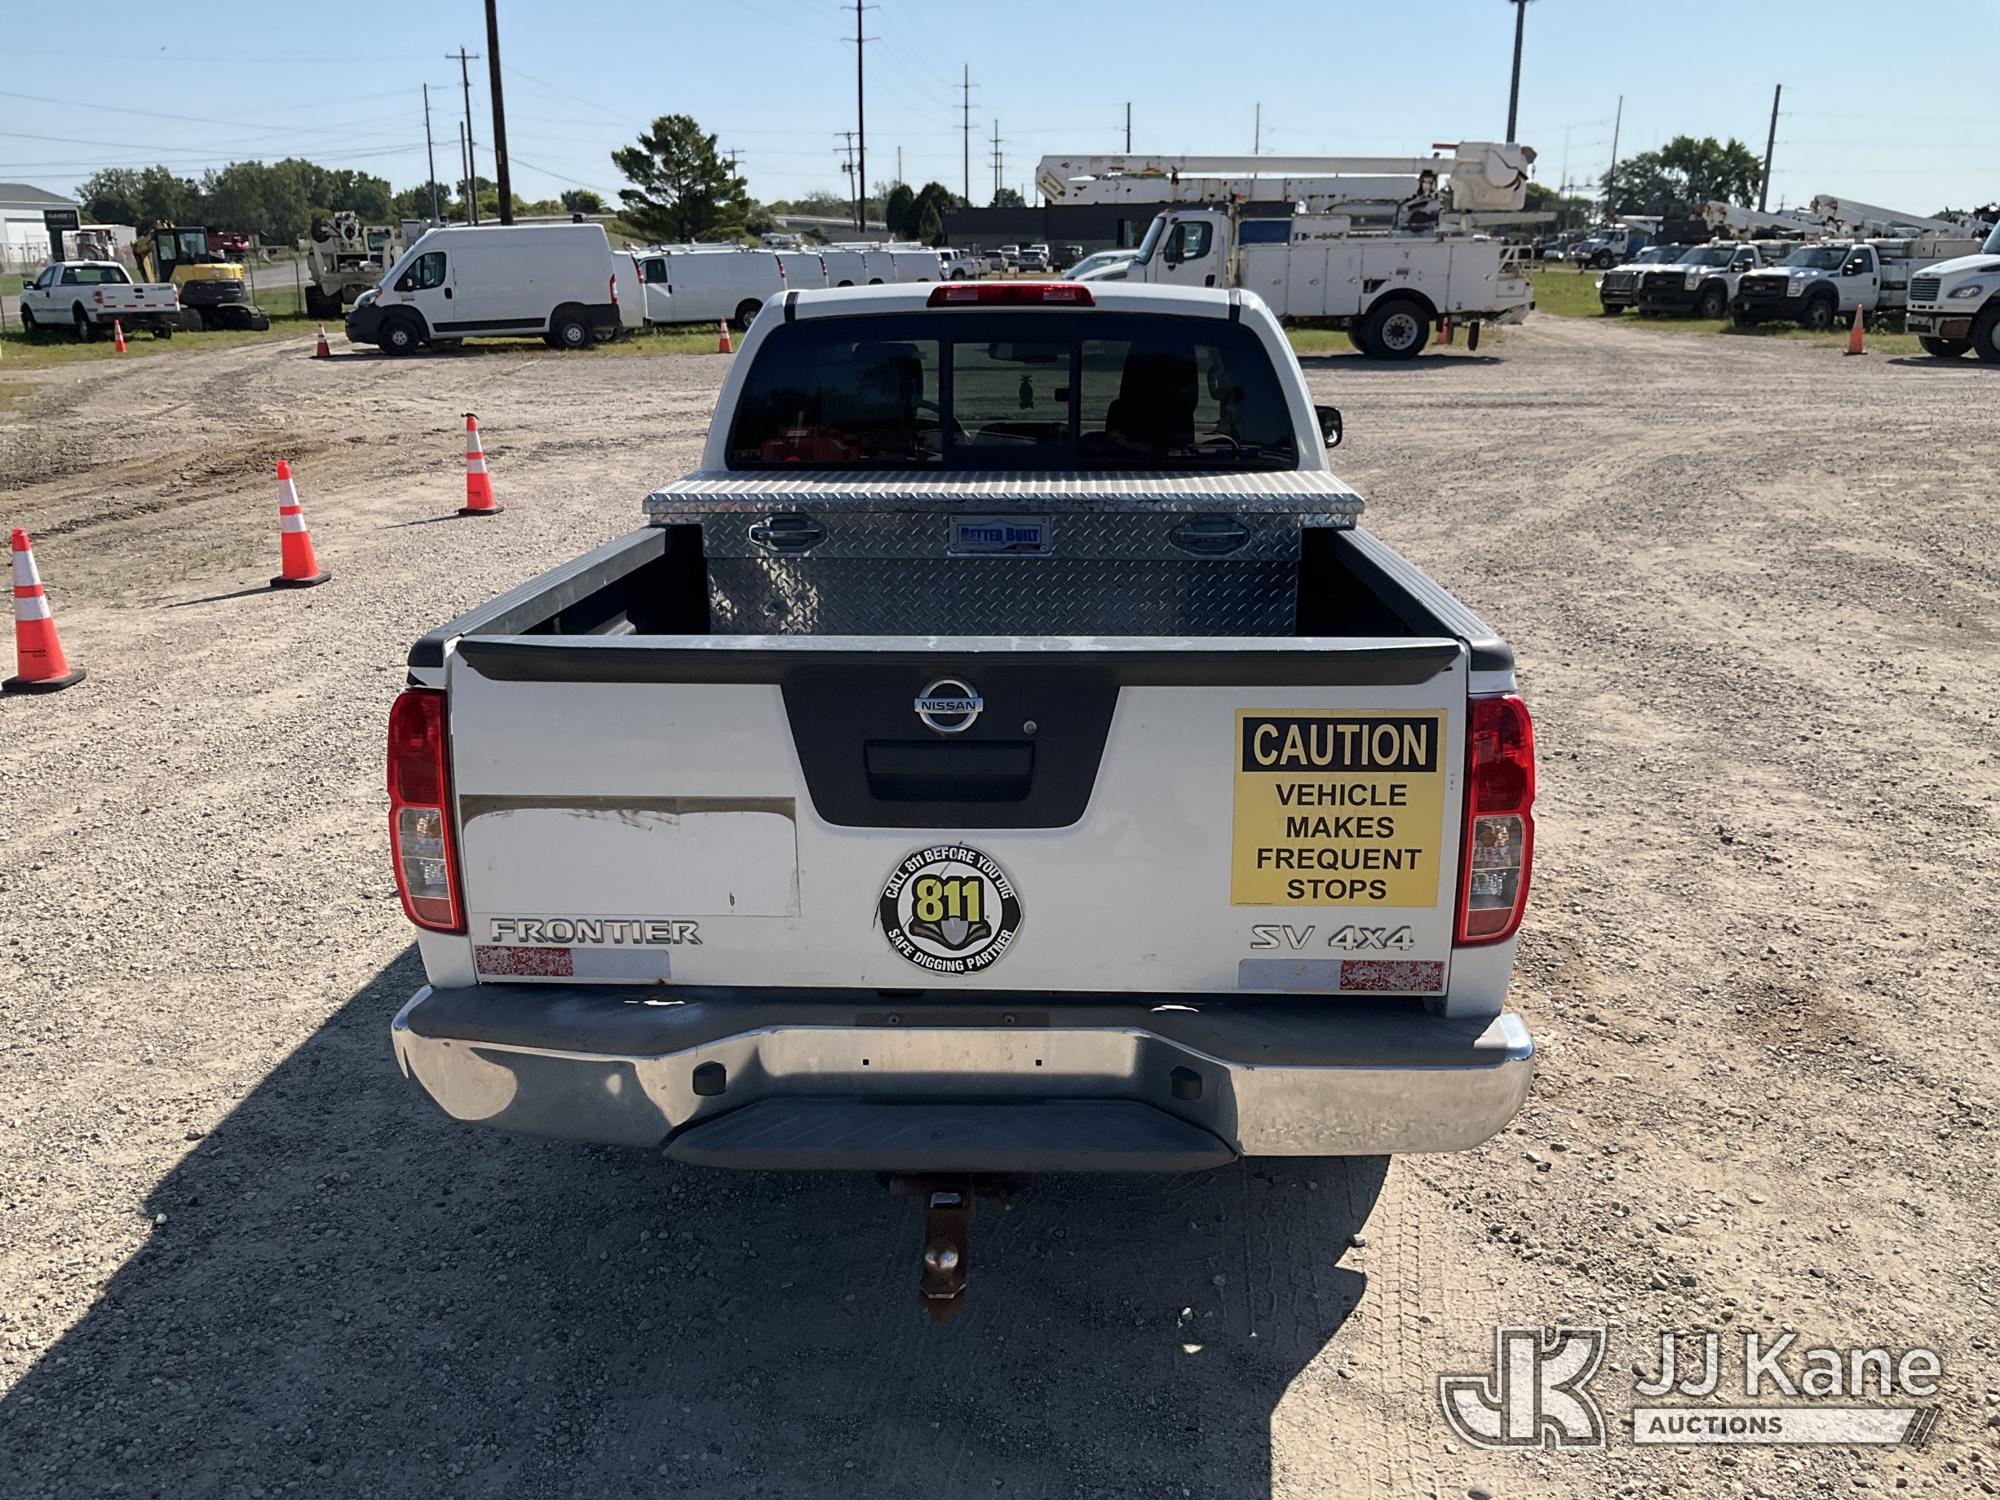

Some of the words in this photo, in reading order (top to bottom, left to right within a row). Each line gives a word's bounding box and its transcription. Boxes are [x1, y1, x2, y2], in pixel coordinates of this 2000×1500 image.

[921, 701, 976, 711] NISSAN
[1253, 723, 1427, 766] CAUTION
[1276, 783, 1407, 806] VEHICLE
[1286, 816, 1395, 838] MAKES
[1257, 848, 1422, 871] FREQUENT
[885, 871, 909, 898] CALL
[905, 854, 925, 872] 811
[924, 847, 976, 864] BEFORE
[977, 855, 1000, 879] YOU
[995, 876, 1013, 899] DIG
[915, 877, 981, 922] 811
[1287, 879, 1387, 900] STOPS
[490, 918, 703, 945] FRONTIER
[1250, 925, 1315, 950] SV
[888, 928, 915, 957] SAFE
[913, 952, 965, 972] DIGGING
[966, 930, 1013, 969] PARTNER
